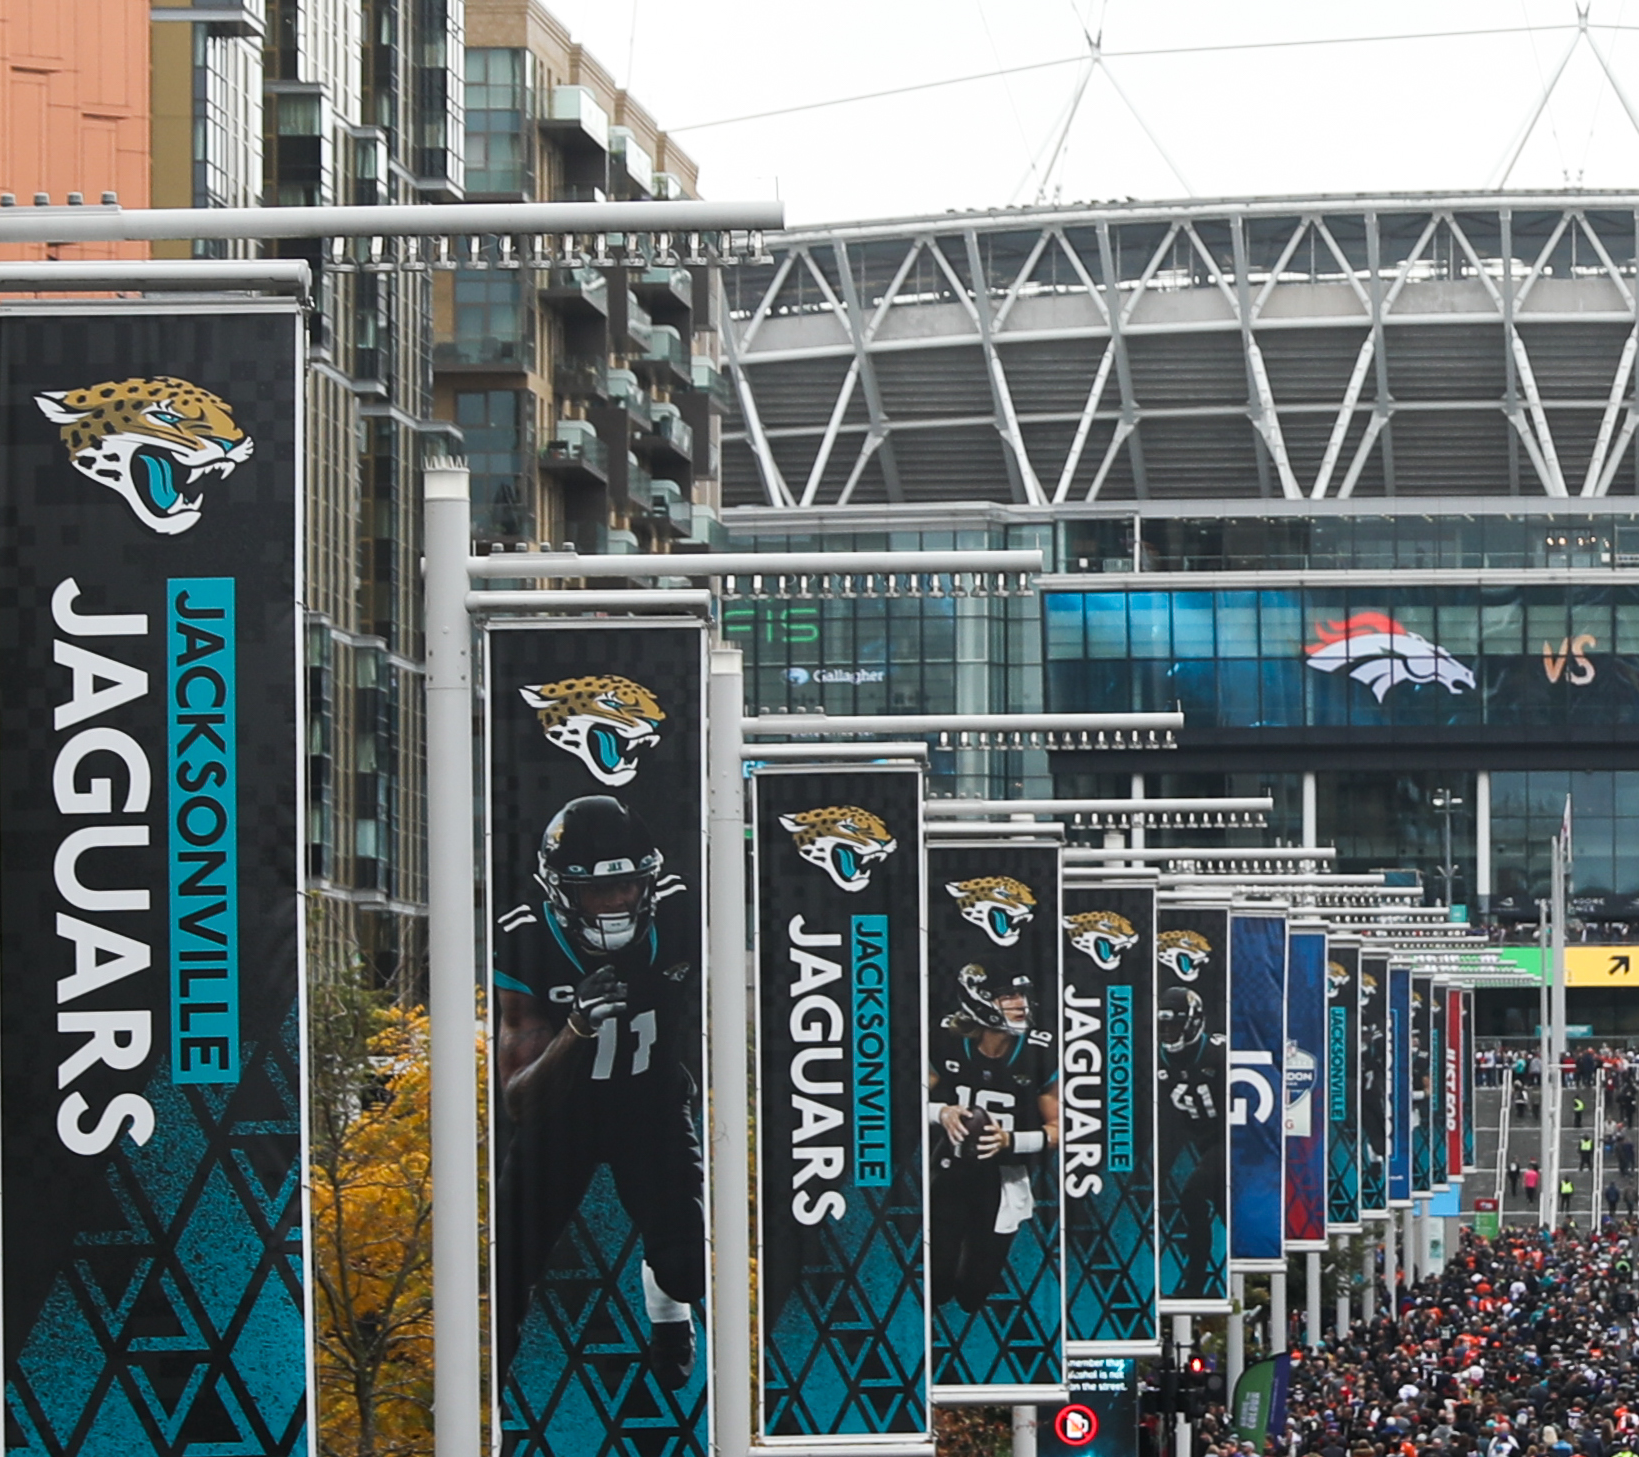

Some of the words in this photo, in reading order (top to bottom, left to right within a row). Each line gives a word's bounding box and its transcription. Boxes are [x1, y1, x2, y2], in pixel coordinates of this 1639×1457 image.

[812, 668, 885, 685] Gallagher
[50, 577, 157, 1157] JAGUARS
[174, 588, 232, 1076] JACKSONVILLE
[590, 1009, 658, 1080] 11
[788, 913, 847, 1227] JAGUARS
[854, 922, 888, 1181] JACKSONVILLE
[1063, 984, 1103, 1198] JAGUARS
[1110, 989, 1129, 1170] JACKSONVILLE
[1330, 1006, 1346, 1122] JACKSONVILLE
